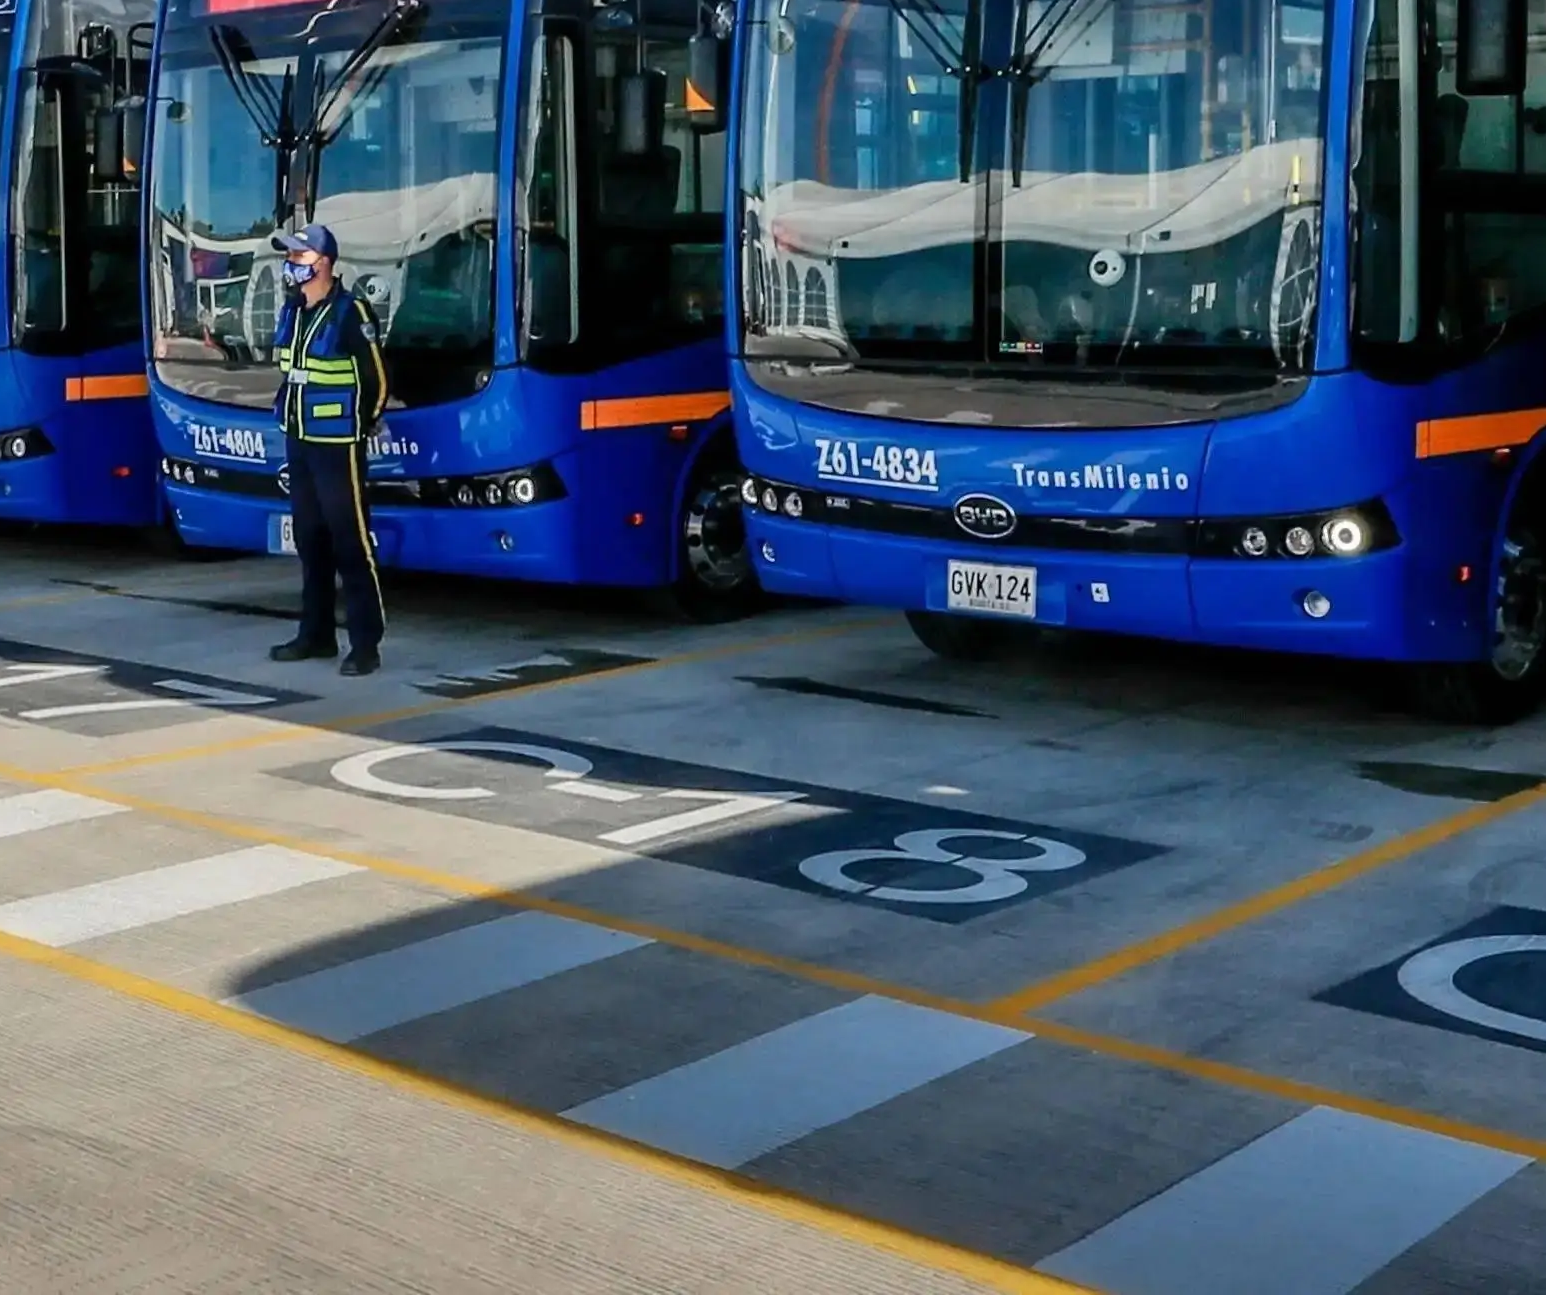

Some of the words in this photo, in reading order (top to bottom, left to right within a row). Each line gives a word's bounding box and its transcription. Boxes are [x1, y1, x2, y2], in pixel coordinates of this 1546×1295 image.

[193, 423, 267, 459] Z61-4804
[815, 438, 939, 486] Z61-4834
[1012, 463, 1190, 491] TransMilenio
[959, 505, 1008, 527] BYD
[951, 570, 988, 599] GVK
[994, 573, 1032, 603] 124
[328, 738, 1088, 904] C-18
